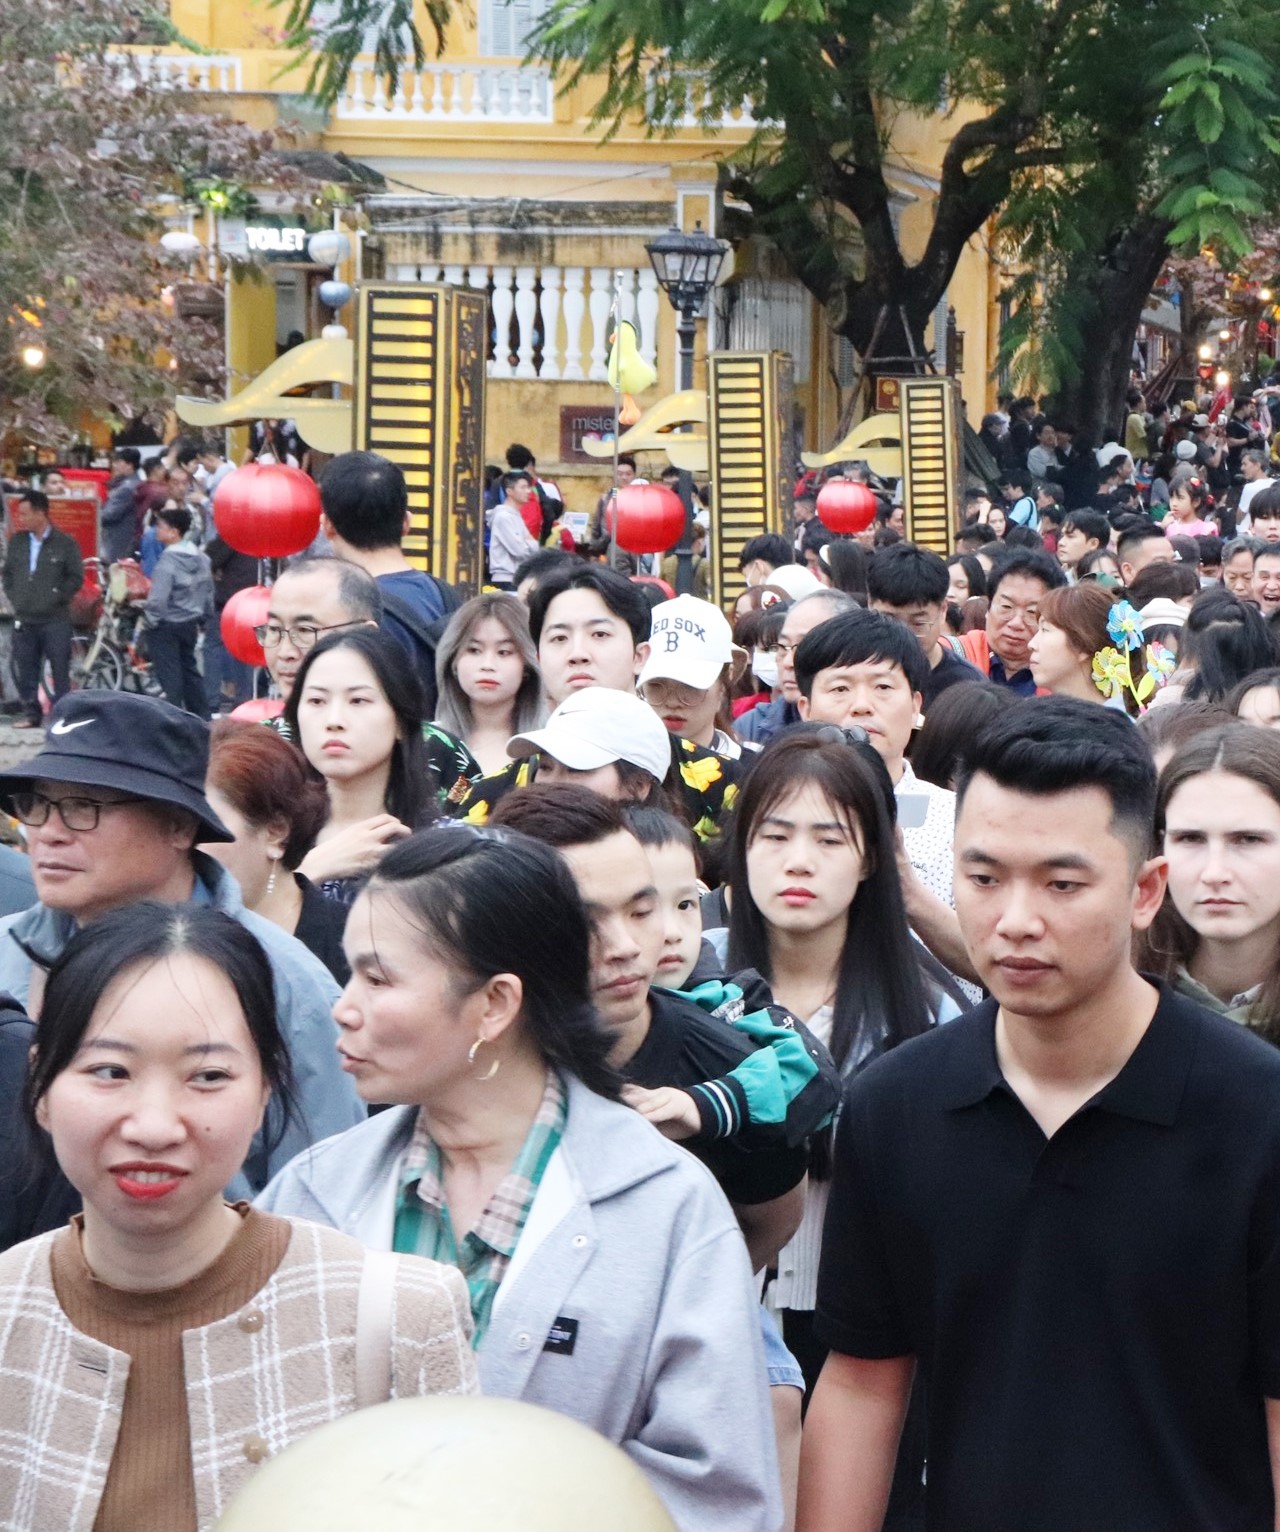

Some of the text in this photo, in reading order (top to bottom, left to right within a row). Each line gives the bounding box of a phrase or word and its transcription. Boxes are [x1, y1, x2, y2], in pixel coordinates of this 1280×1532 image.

[245, 227, 306, 251] TOILET
[573, 417, 615, 431] miste
[652, 617, 706, 643] ED SOX
[664, 631, 679, 652] B
